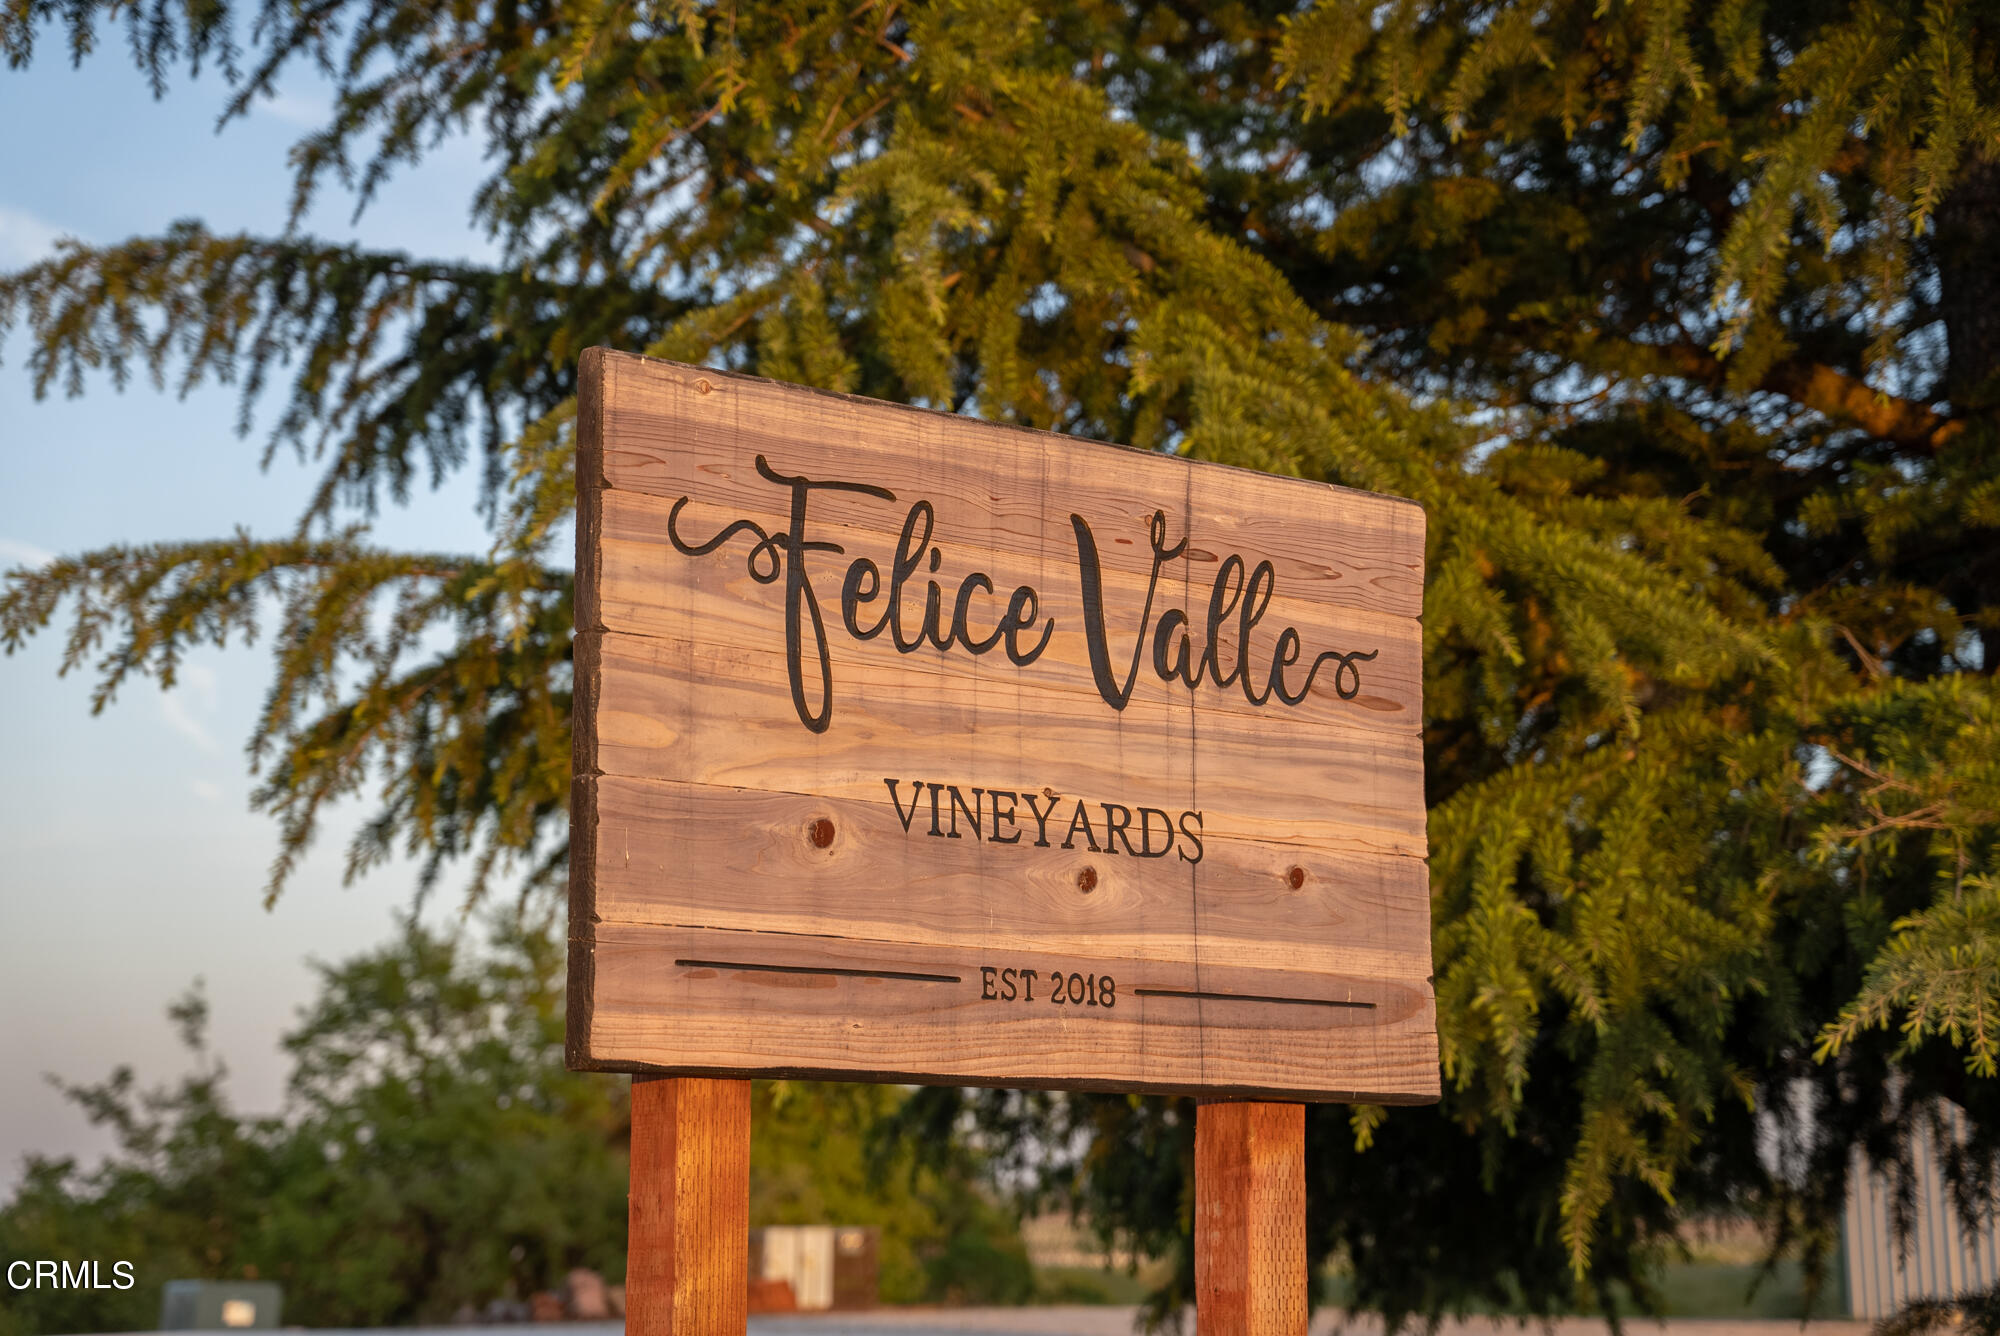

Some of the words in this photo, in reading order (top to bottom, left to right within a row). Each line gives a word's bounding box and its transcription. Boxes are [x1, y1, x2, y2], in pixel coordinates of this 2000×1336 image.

[668, 454, 1055, 734] Felice
[1070, 509, 1379, 711] Valle
[883, 778, 1205, 865] VINEYARDS
[980, 966, 1038, 1001] EST
[1050, 971, 1117, 1008] 2018
